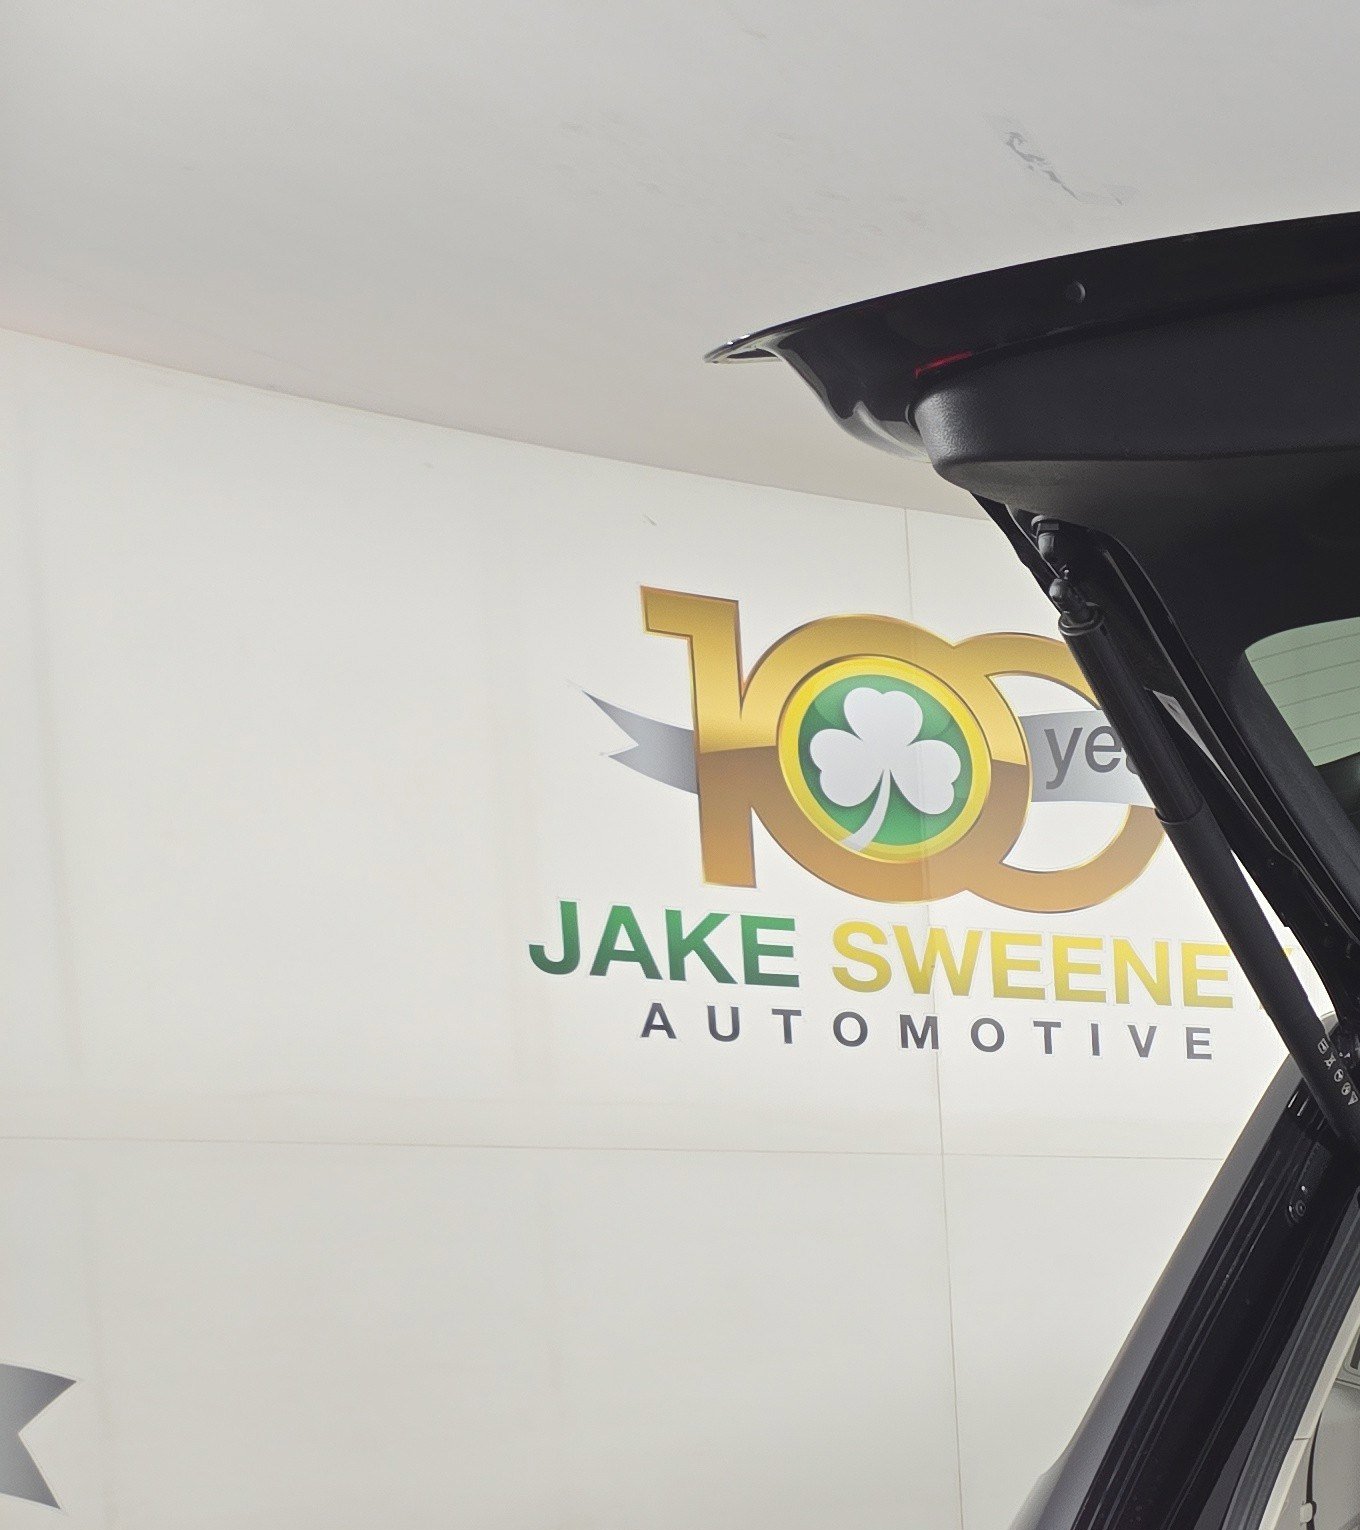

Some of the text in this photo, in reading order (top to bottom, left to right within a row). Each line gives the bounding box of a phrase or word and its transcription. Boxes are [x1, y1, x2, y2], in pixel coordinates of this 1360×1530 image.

[529, 900, 1292, 1009] JAKE SWEENE
[640, 1002, 1213, 1061] AUTOMOTIVE
